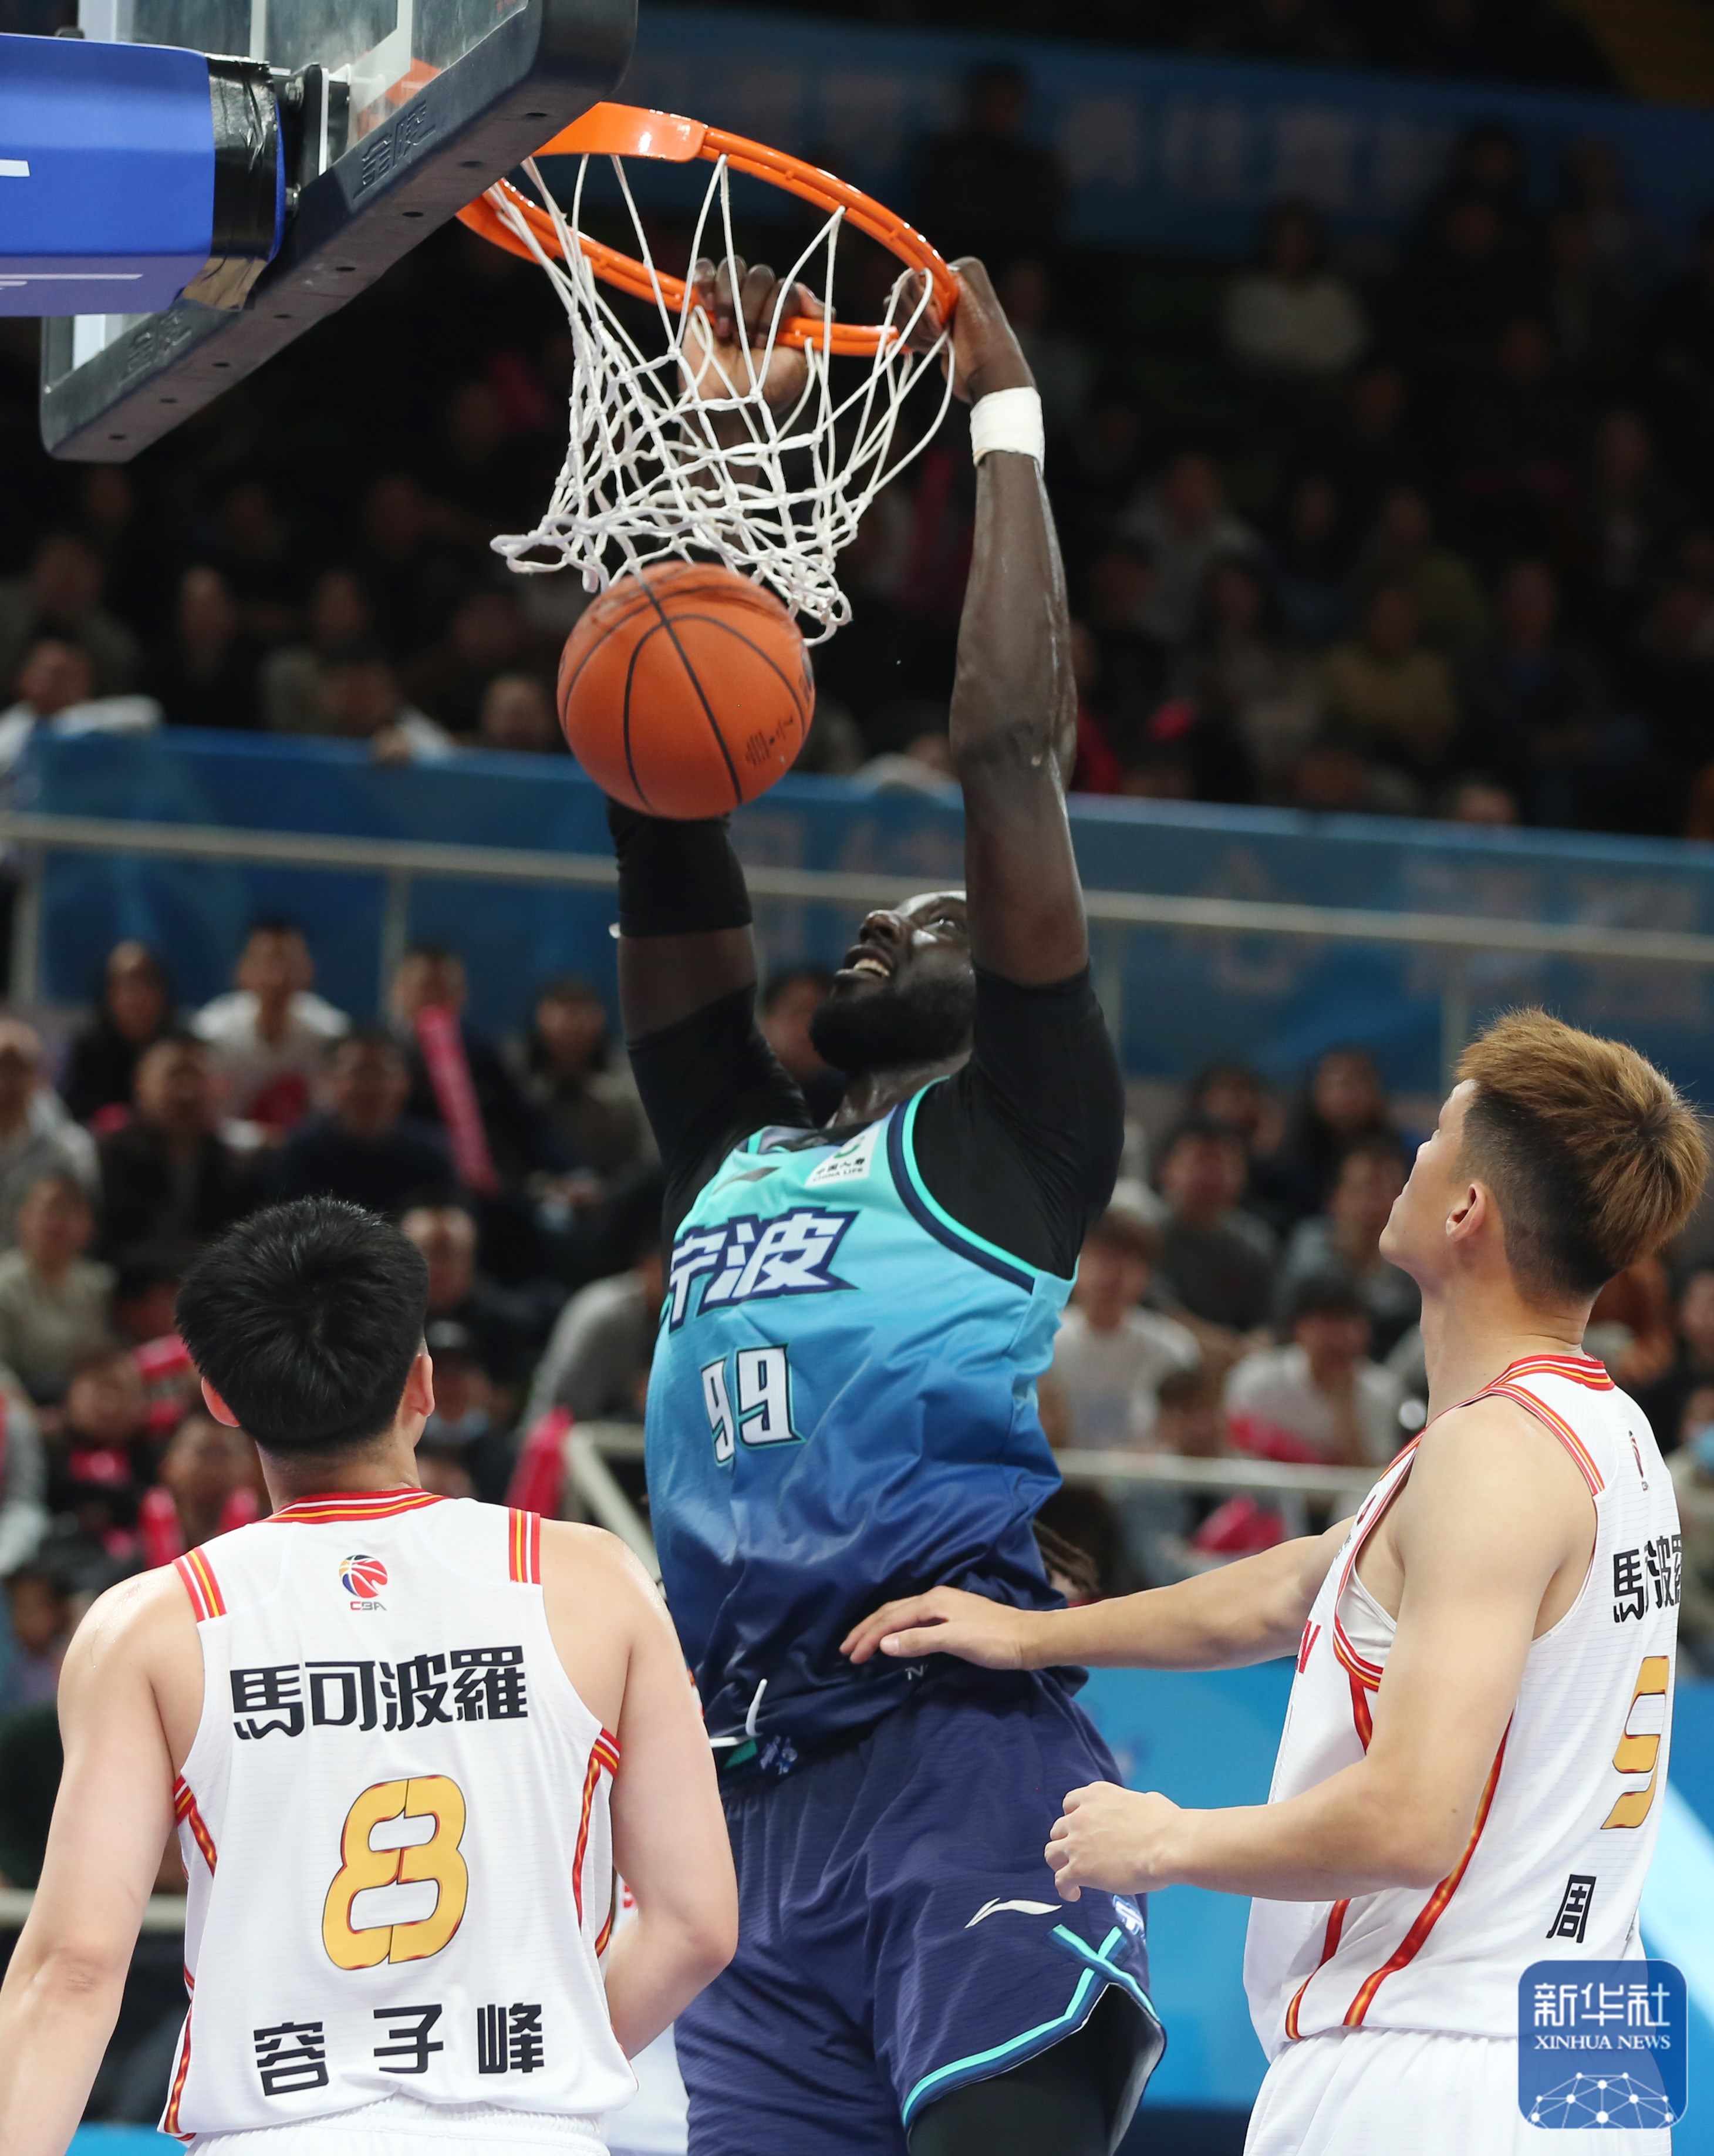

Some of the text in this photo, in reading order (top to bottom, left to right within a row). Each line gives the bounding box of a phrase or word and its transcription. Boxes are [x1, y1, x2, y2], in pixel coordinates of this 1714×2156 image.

[701, 1345, 807, 1466] 99
[350, 1601, 387, 1611] CBA
[230, 1646, 528, 1740] 馬可波羅
[322, 1774, 468, 1970] 8
[1546, 1874, 1597, 1943] 周
[254, 2002, 545, 2096] 容子峰
